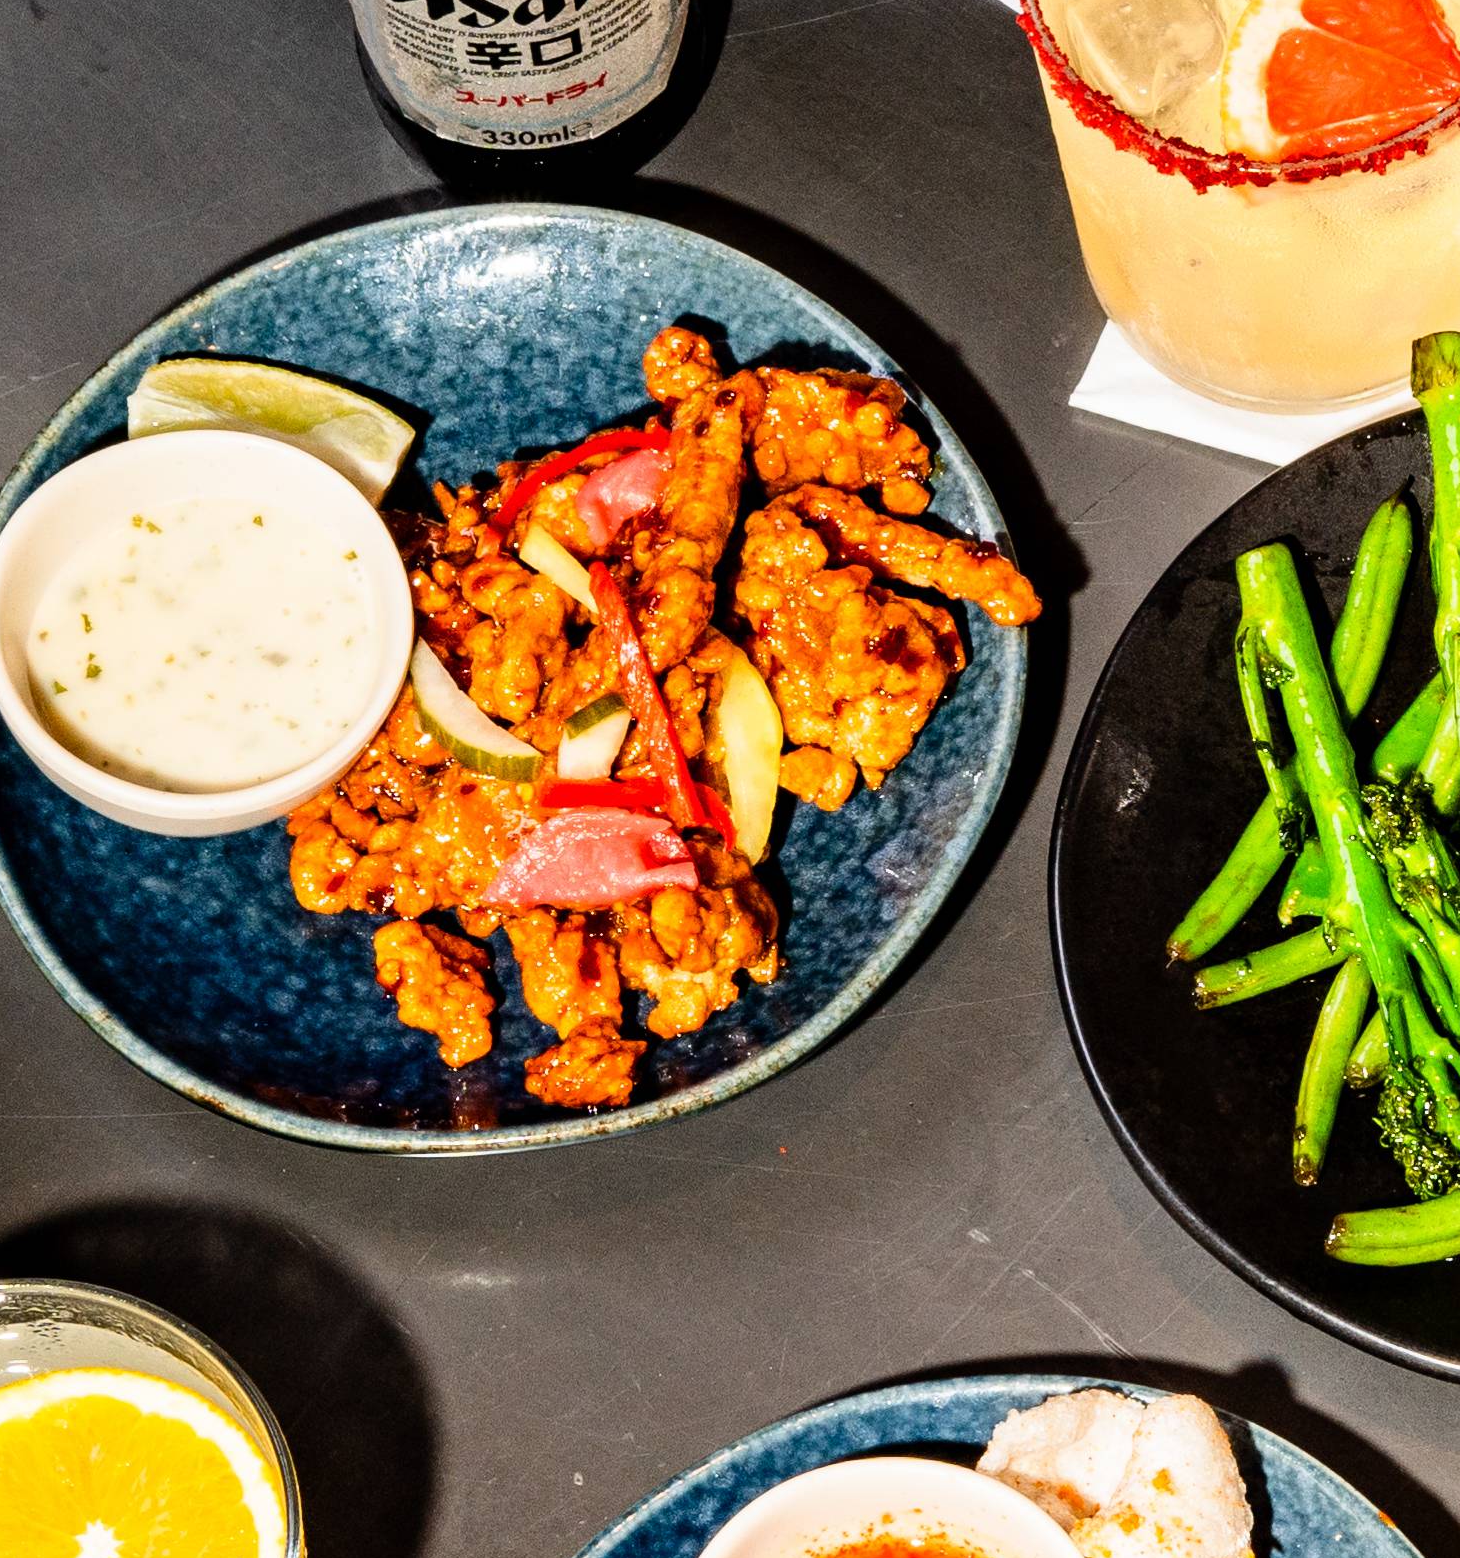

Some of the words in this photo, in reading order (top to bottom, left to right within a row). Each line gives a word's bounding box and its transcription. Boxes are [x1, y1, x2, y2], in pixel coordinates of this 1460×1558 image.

[467, 30, 508, 40] BREWED
[508, 29, 534, 38] WITH
[534, 15, 583, 38] PRECISION
[465, 27, 583, 71] 辛口
[452, 70, 608, 108] スーパードライ
